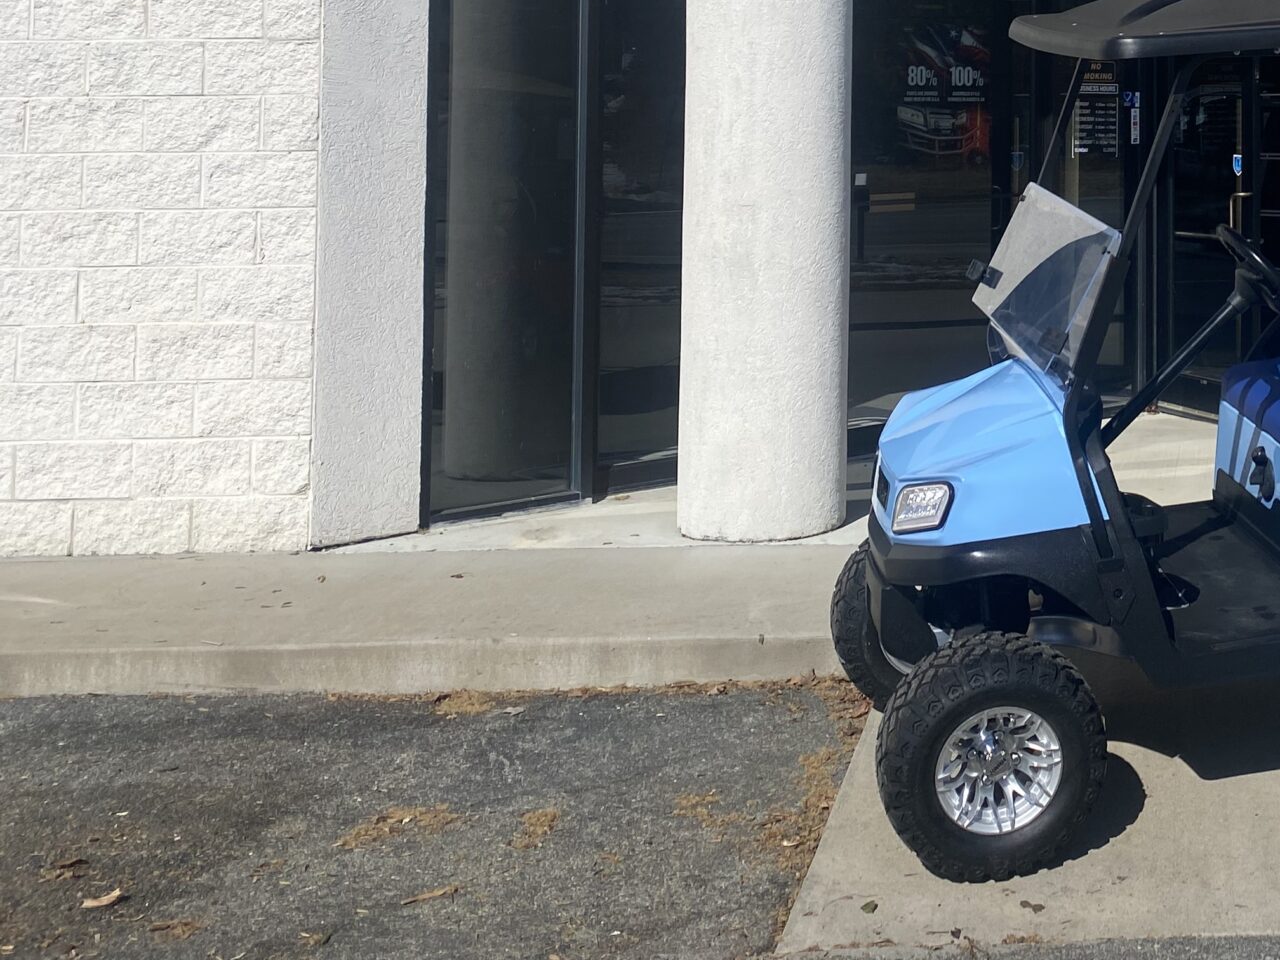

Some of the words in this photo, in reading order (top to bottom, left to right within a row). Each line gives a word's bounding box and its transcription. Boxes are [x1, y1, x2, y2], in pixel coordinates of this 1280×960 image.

[1090, 63, 1102, 71] NO
[907, 65, 938, 86] 80%
[949, 66, 985, 87] 100%
[1083, 72, 1113, 80] MOKING
